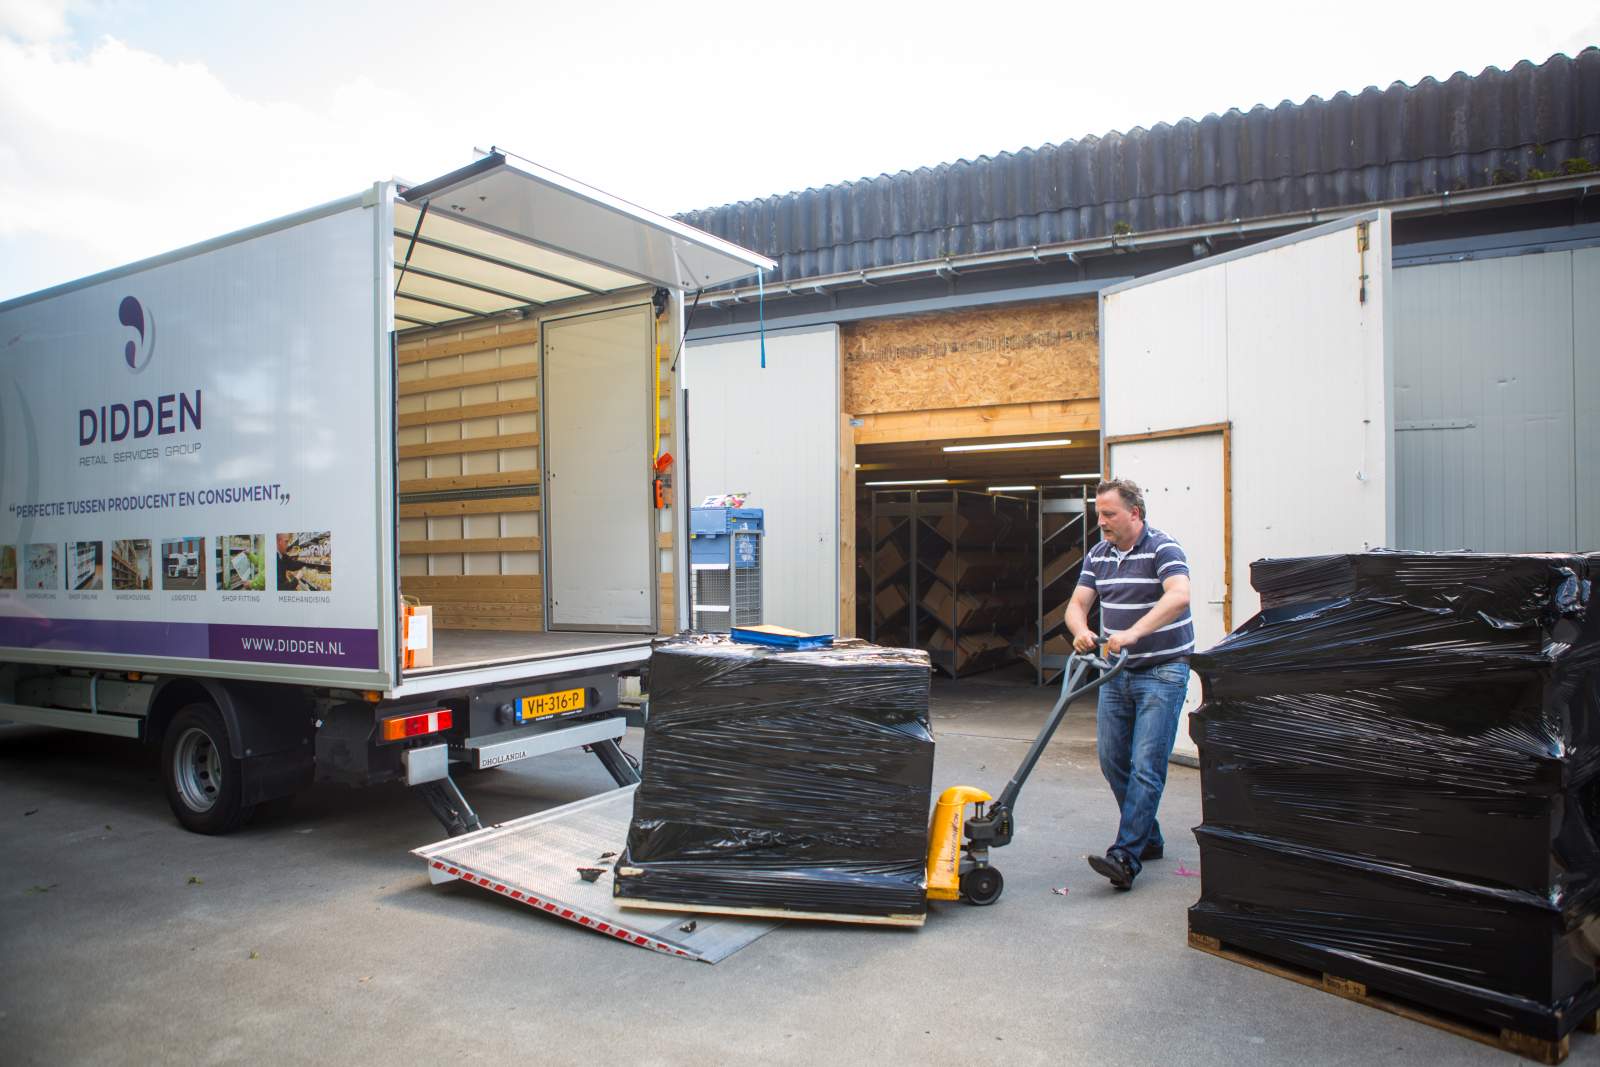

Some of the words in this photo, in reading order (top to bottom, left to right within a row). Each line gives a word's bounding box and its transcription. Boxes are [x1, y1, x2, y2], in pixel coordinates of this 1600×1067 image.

[79, 389, 202, 446] DIDDEN
[79, 455, 109, 467] RETAIL
[113, 448, 159, 464] SERVICES
[165, 442, 202, 457] GROUP
[66, 499, 106, 514] TUSSEN
[108, 492, 176, 512] PRODUCENT
[179, 492, 195, 507] EN
[171, 594, 197, 602] LOGISTICS
[222, 594, 237, 602] SHOP
[238, 595, 260, 603] FITTING
[278, 595, 331, 604] MERCHANDISING
[241, 637, 346, 655] WWW.DIDDEN.NL
[528, 692, 579, 715] VH-316-P
[482, 751, 526, 767] DHOLLANDIA
